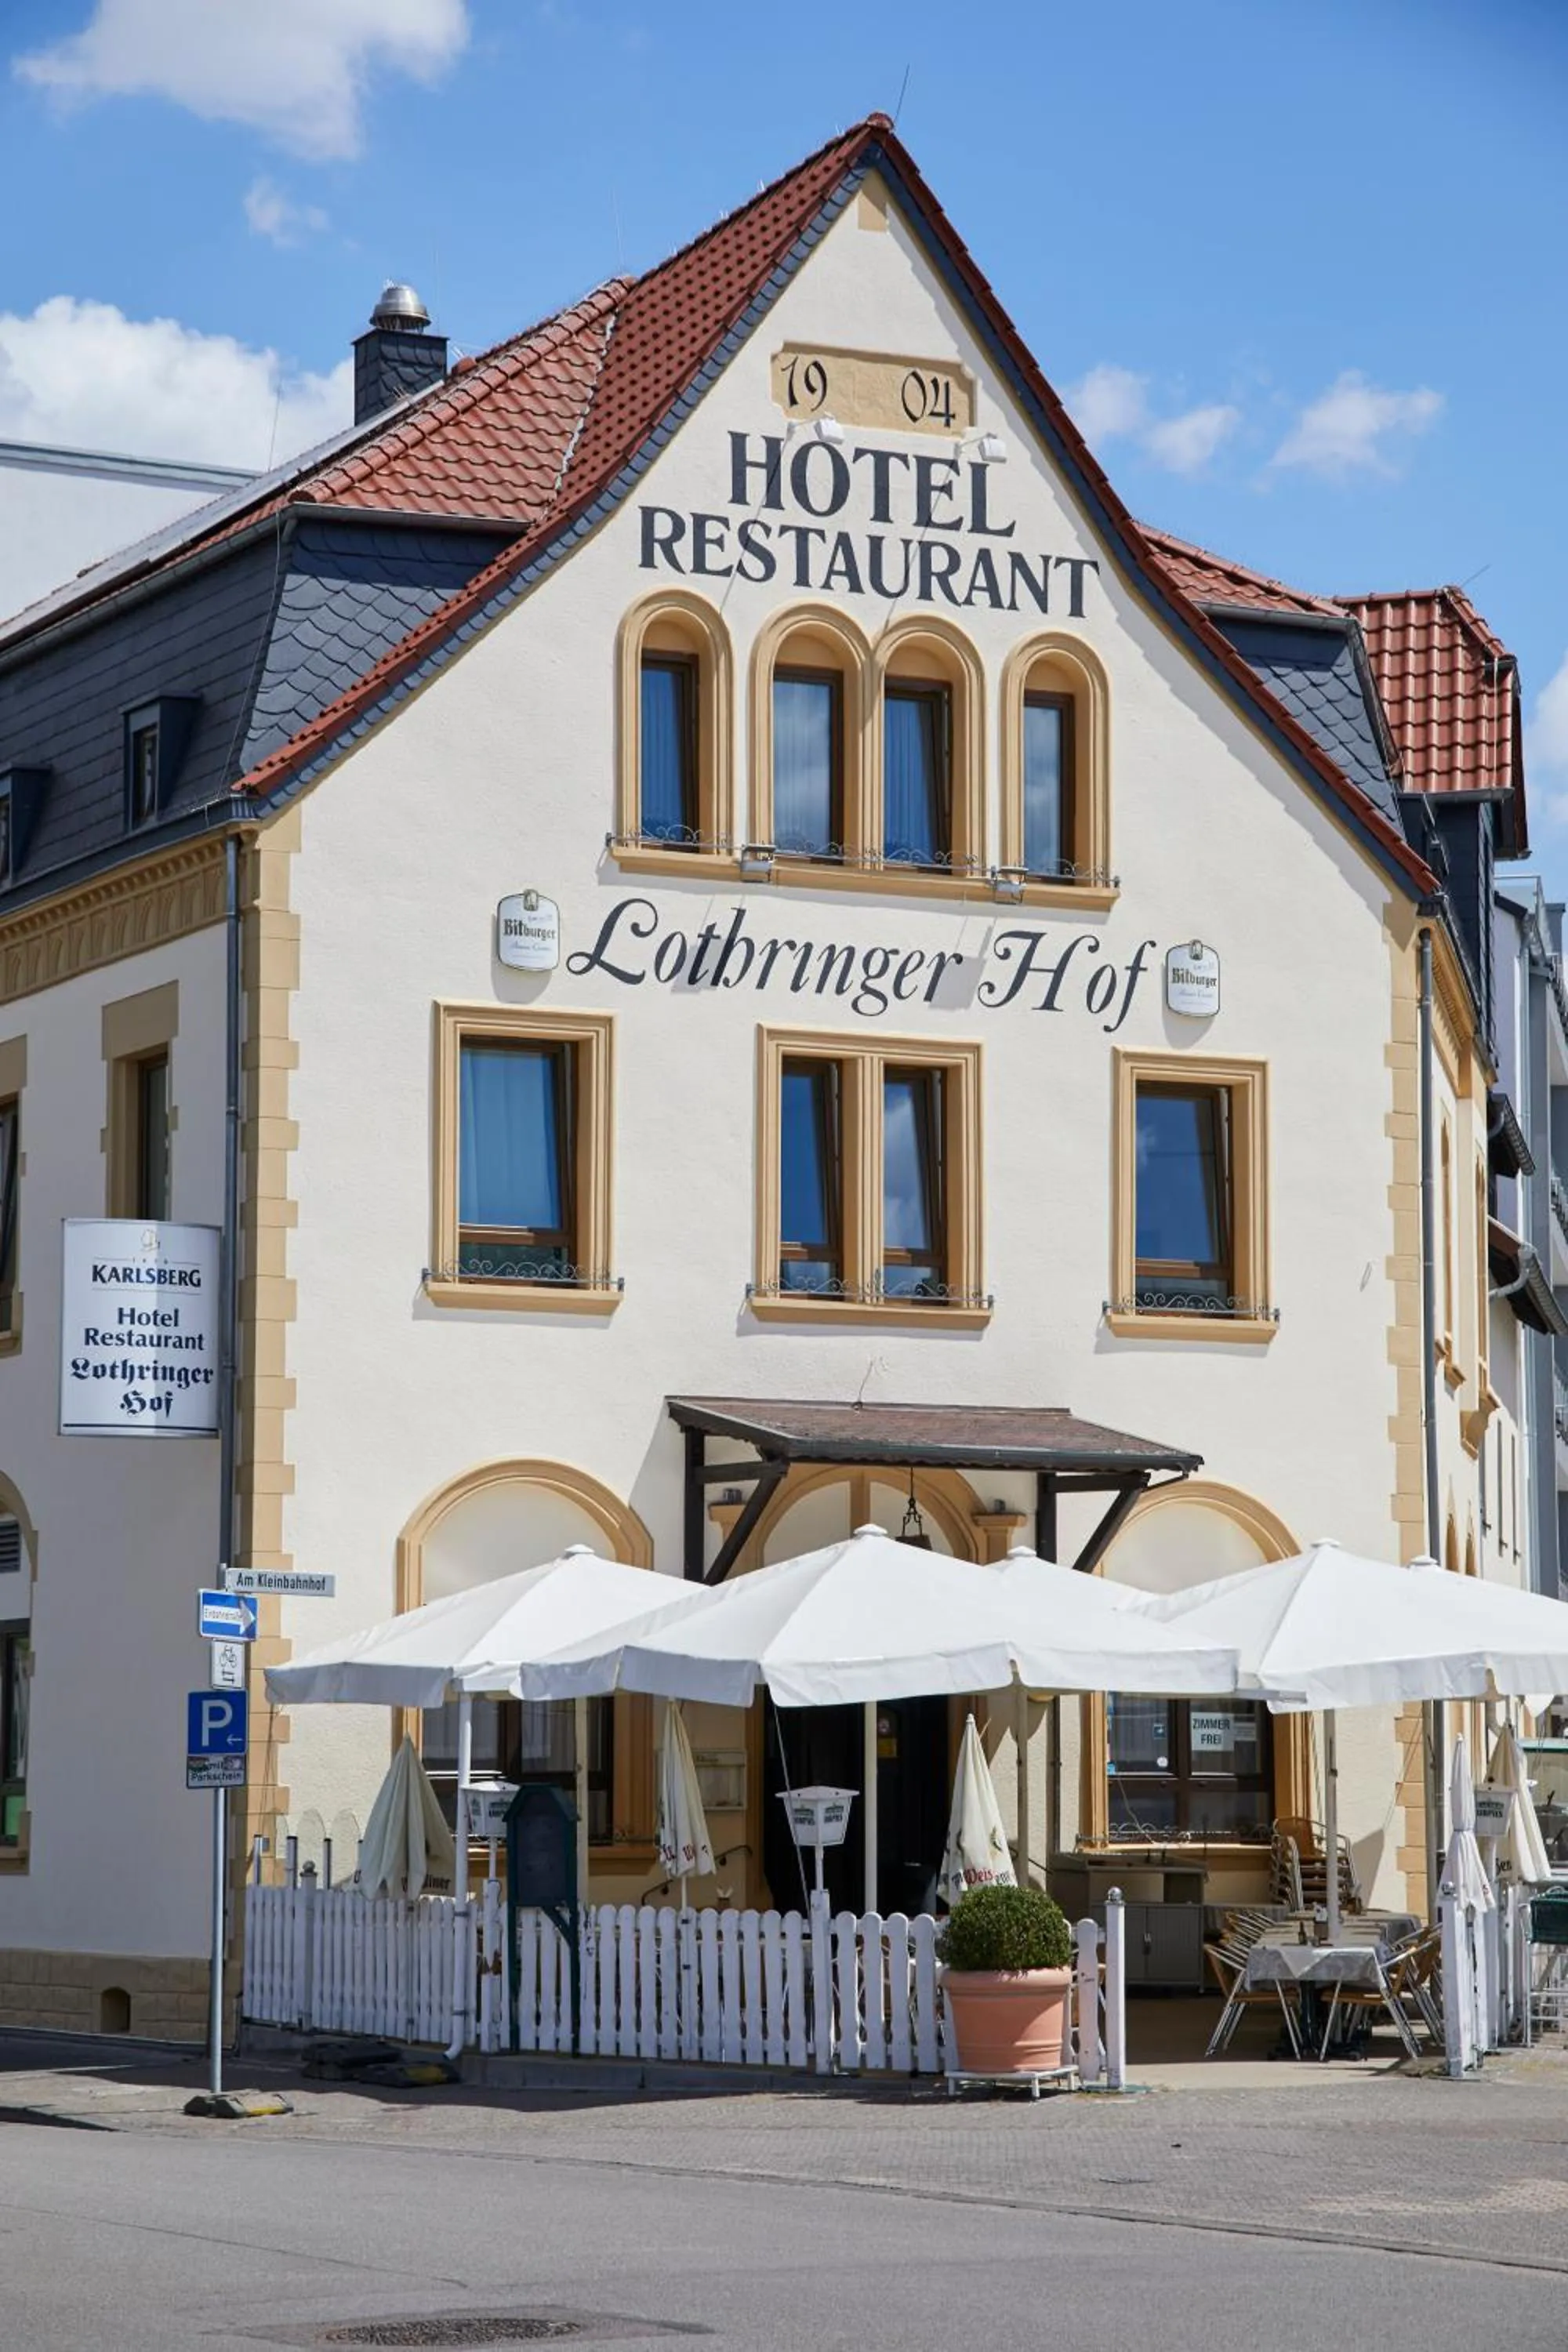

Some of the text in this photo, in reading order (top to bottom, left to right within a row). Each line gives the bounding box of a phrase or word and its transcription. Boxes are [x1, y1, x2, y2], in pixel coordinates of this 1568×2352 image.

[781, 356, 957, 428] 19 04
[728, 430, 1016, 538] HOTEL
[637, 505, 1100, 619] RESTAURANT
[503, 917, 557, 941] Bitburger
[566, 898, 1157, 1033] Lothringer Hof
[1171, 966, 1218, 989] Bitburger
[91, 1264, 201, 1288] KARLSBERG
[117, 1307, 180, 1327] Hotel
[84, 1327, 205, 1351] Restaurant
[71, 1357, 214, 1390] Lothringer
[119, 1390, 174, 1418] Hof
[236, 1572, 326, 1592] Am Kleinbahnhof
[201, 1699, 233, 1748] P
[1192, 1718, 1230, 1730] ZIMMER
[1200, 1733, 1222, 1744] FREI
[191, 1770, 242, 1782] Parkschein
